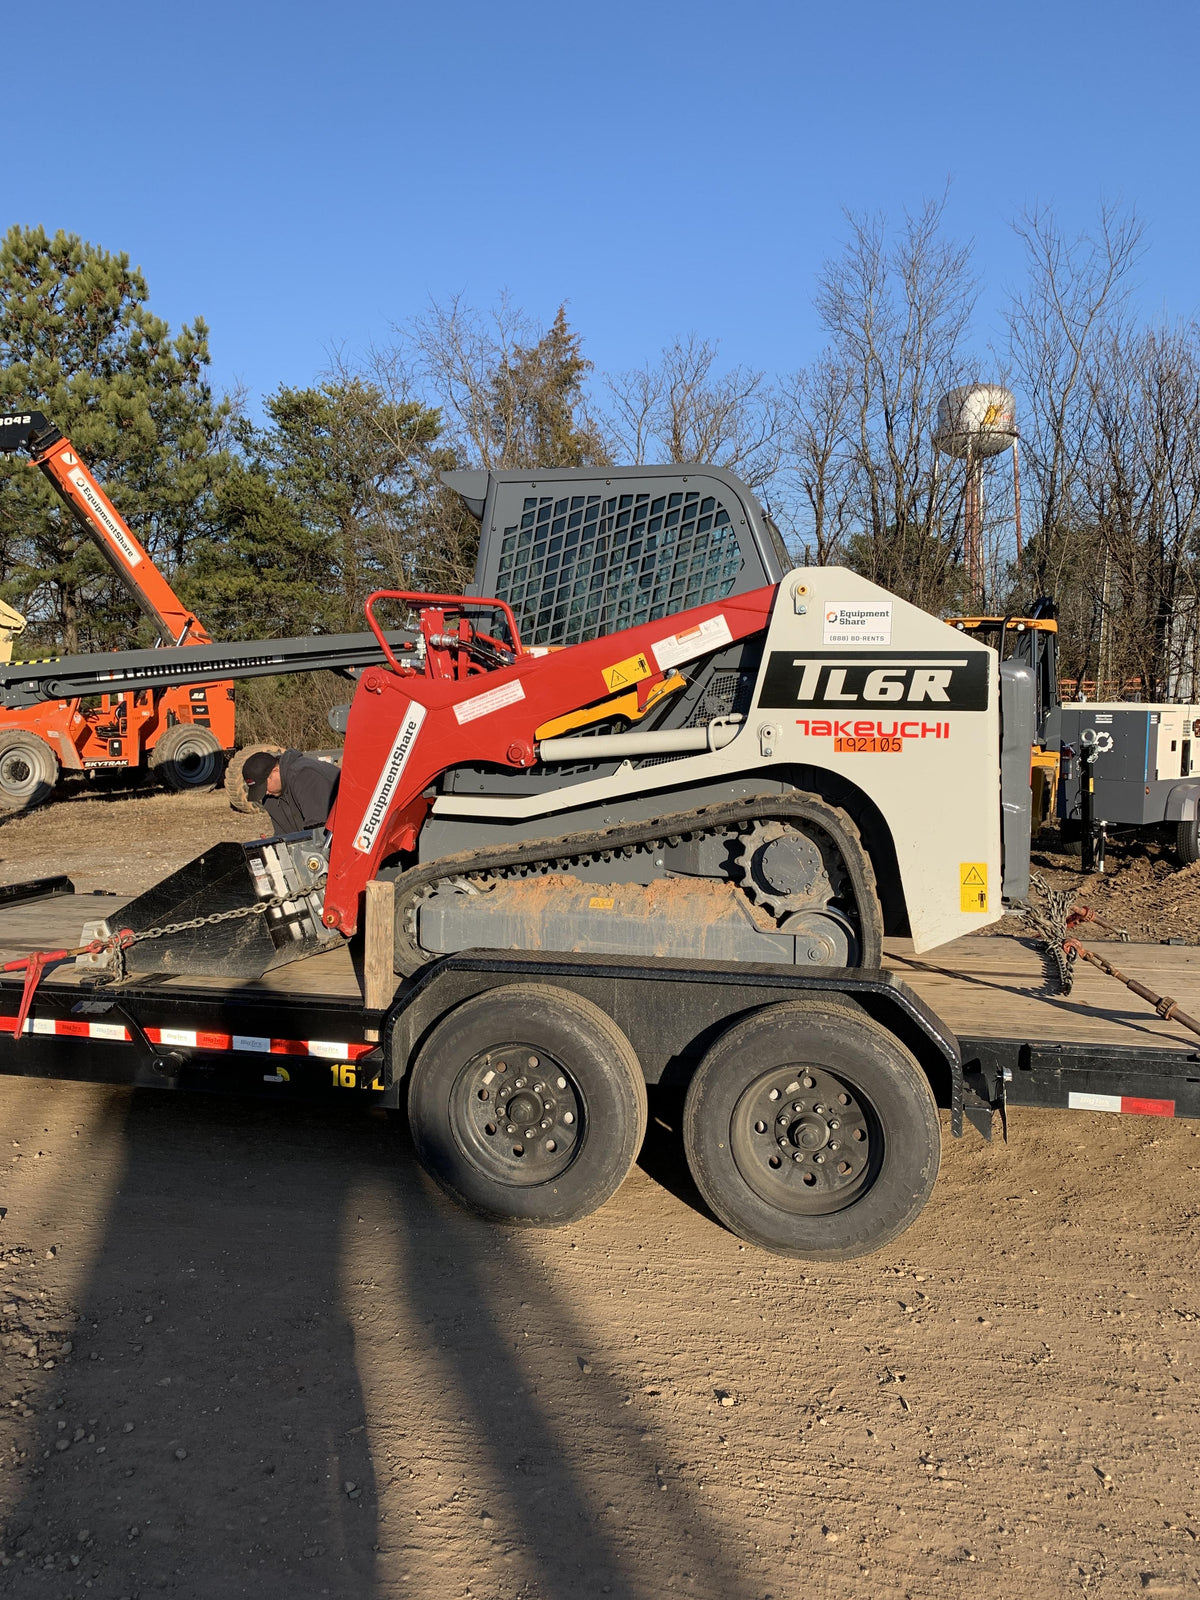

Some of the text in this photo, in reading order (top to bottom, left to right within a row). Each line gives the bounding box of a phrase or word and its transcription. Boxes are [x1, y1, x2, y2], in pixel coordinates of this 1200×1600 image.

[83, 486, 133, 557] EquipmentShare
[839, 610, 889, 619] Equipment
[792, 659, 968, 702] TL6R
[836, 737, 902, 752] 192105
[85, 760, 128, 768] SKYTRAK
[364, 721, 417, 835] EquipmentShare
